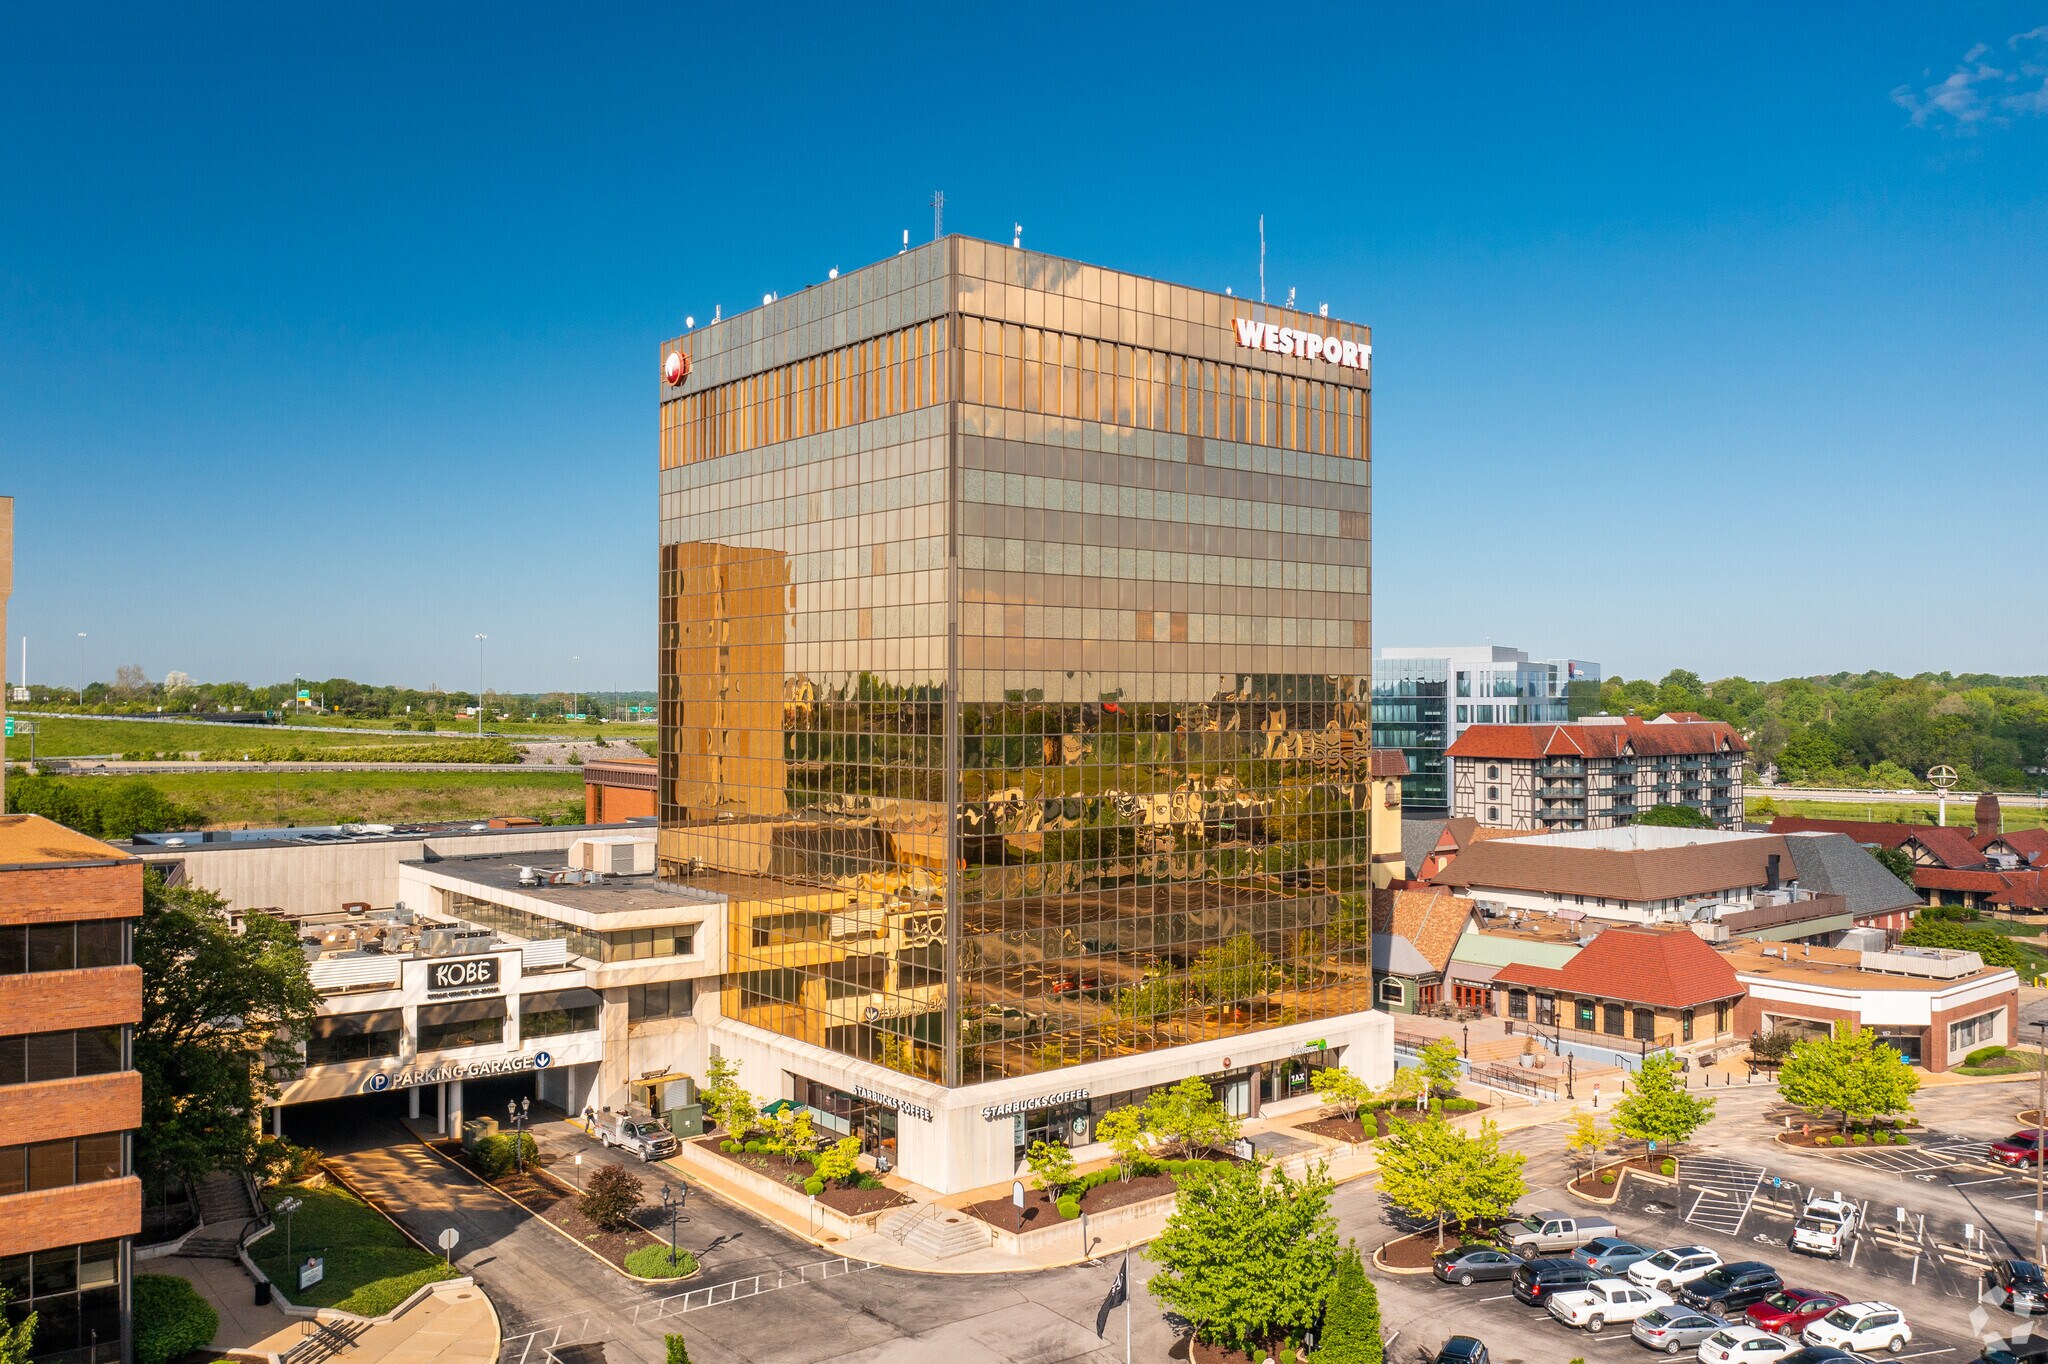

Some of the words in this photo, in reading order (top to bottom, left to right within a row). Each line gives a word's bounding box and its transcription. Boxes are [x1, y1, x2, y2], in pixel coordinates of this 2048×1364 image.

[1234, 317, 1372, 370] WESTPORT
[436, 960, 491, 986] KOBE
[375, 1076, 385, 1089] P
[392, 1065, 464, 1088] PARKING
[467, 1056, 533, 1077] GARAGE
[1291, 1073, 1305, 1082] TAX
[853, 1085, 899, 1109] STARBUCKS
[900, 1101, 932, 1121] COFFEE
[984, 1096, 1049, 1118] STARBUCKS
[1050, 1088, 1089, 1104] COFFEE
